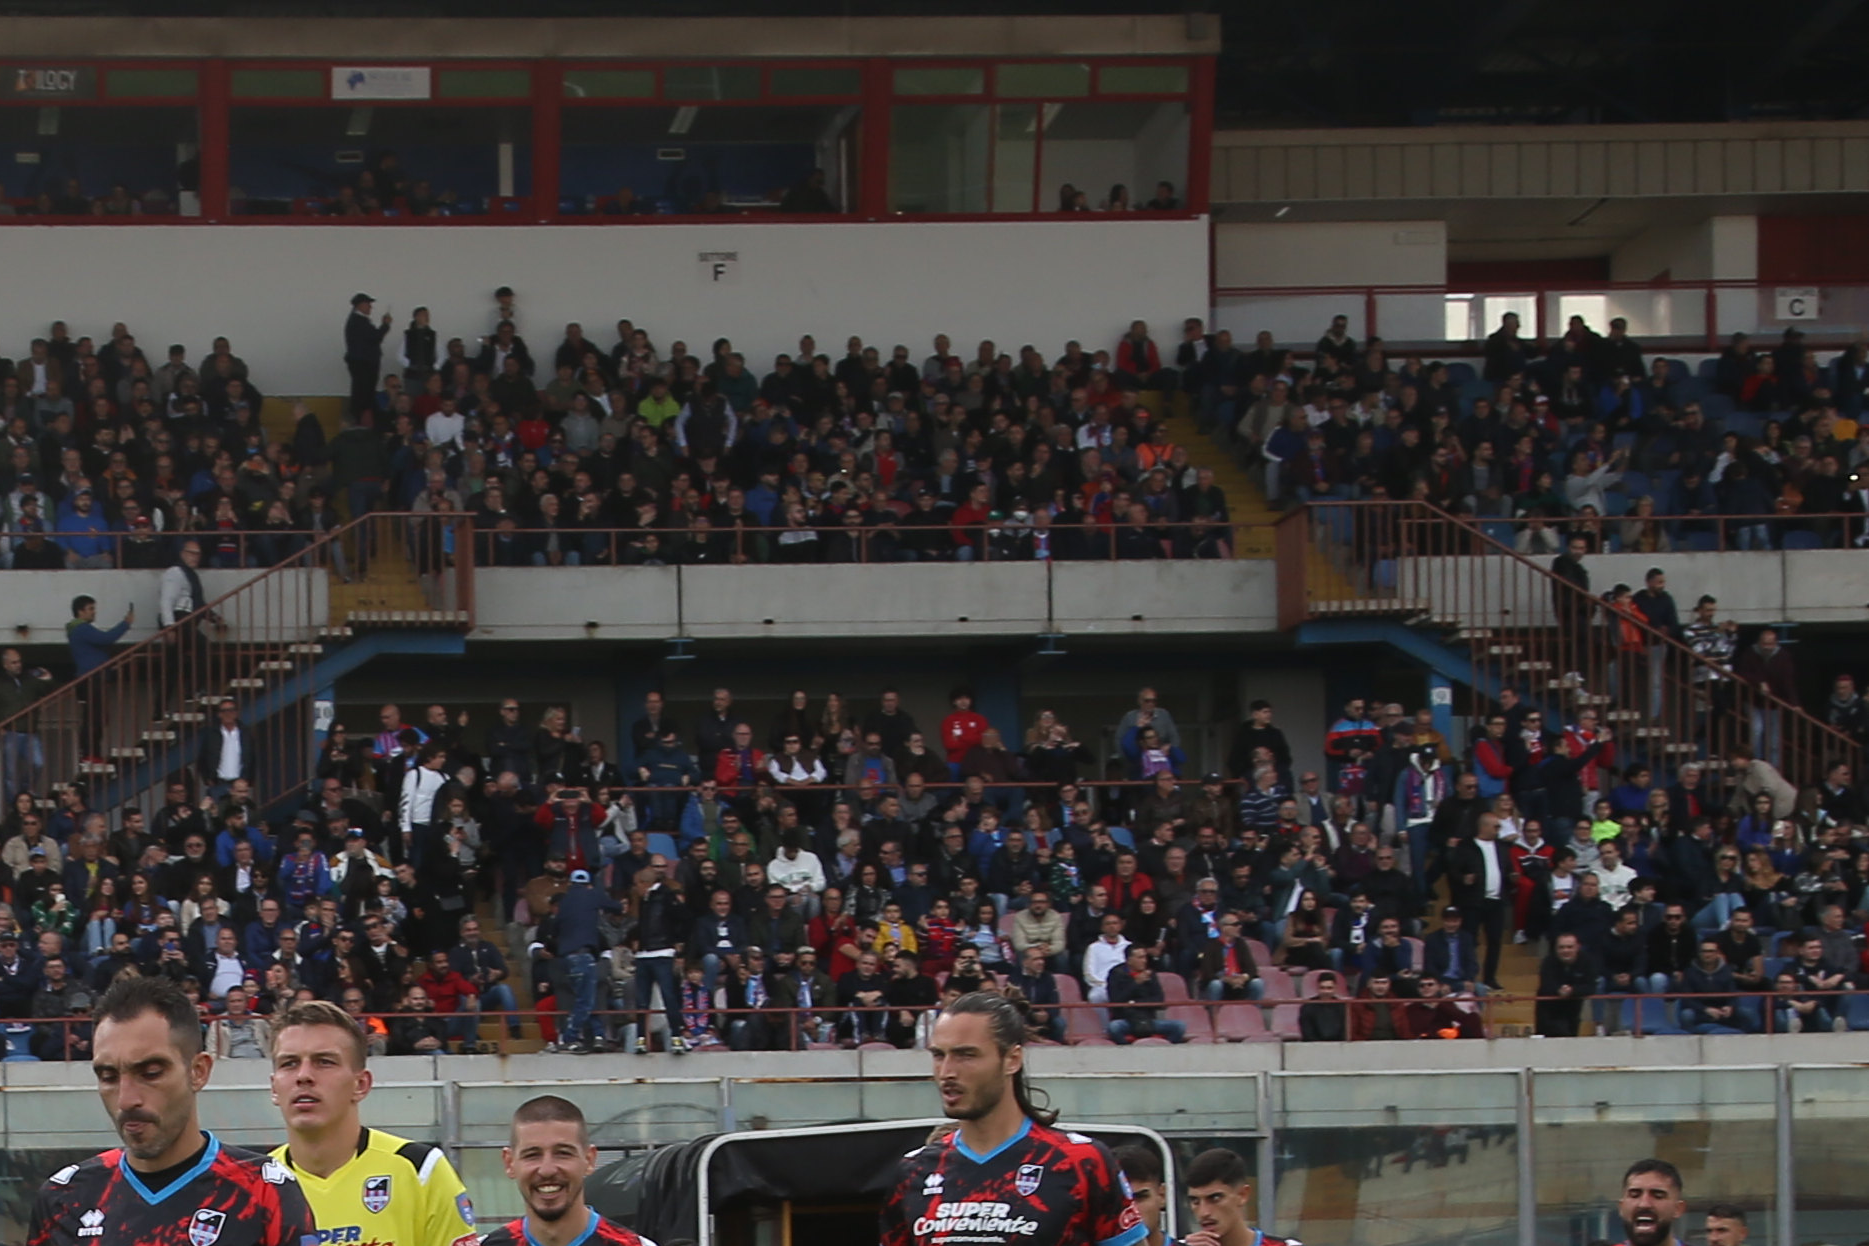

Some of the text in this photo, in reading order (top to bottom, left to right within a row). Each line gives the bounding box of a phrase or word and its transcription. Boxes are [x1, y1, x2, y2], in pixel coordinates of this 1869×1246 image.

[713, 263, 726, 281] F
[1789, 298, 1805, 316] C
[935, 1202, 1011, 1219] SUPER
[913, 1214, 1039, 1237] Conveniente
[317, 1226, 362, 1244] PER
